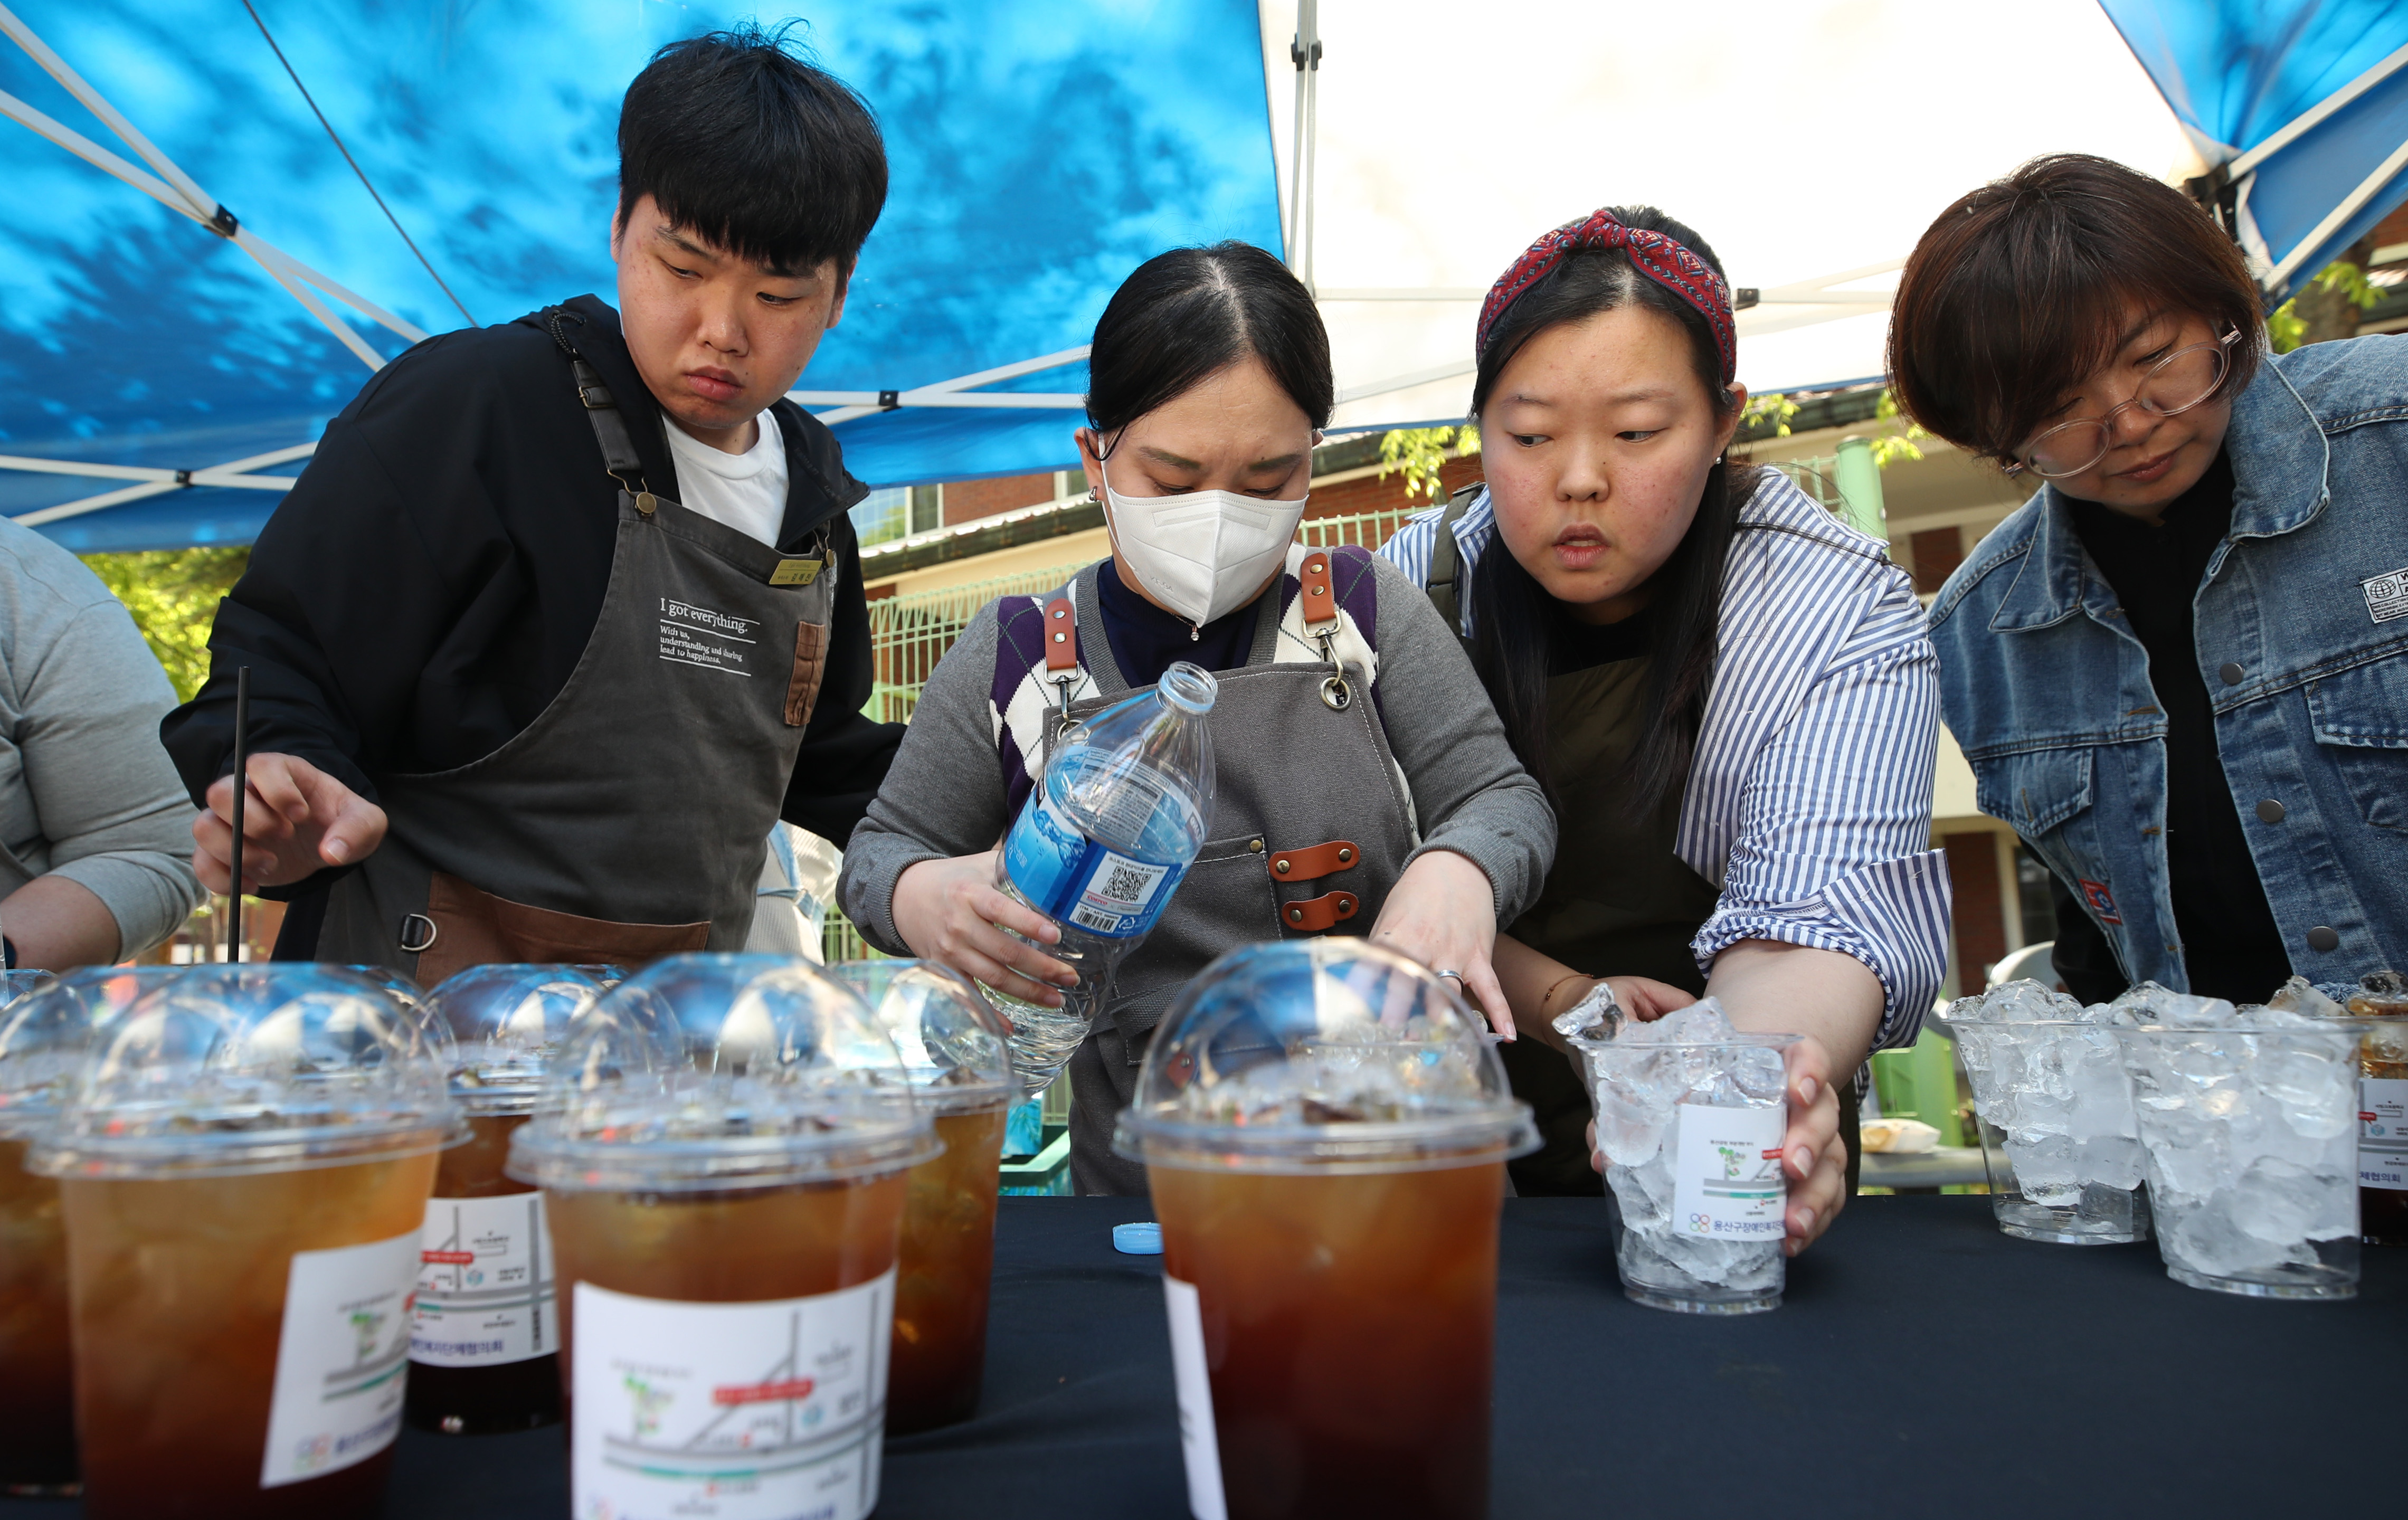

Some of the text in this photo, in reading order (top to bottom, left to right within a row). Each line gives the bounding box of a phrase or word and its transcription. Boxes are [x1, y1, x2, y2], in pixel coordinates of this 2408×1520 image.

[660, 597, 748, 634] I got everything.
[660, 625, 690, 640] With us,
[660, 636, 710, 654] understanding
[660, 644, 675, 655] lead
[1087, 895, 1108, 905] COSTCO
